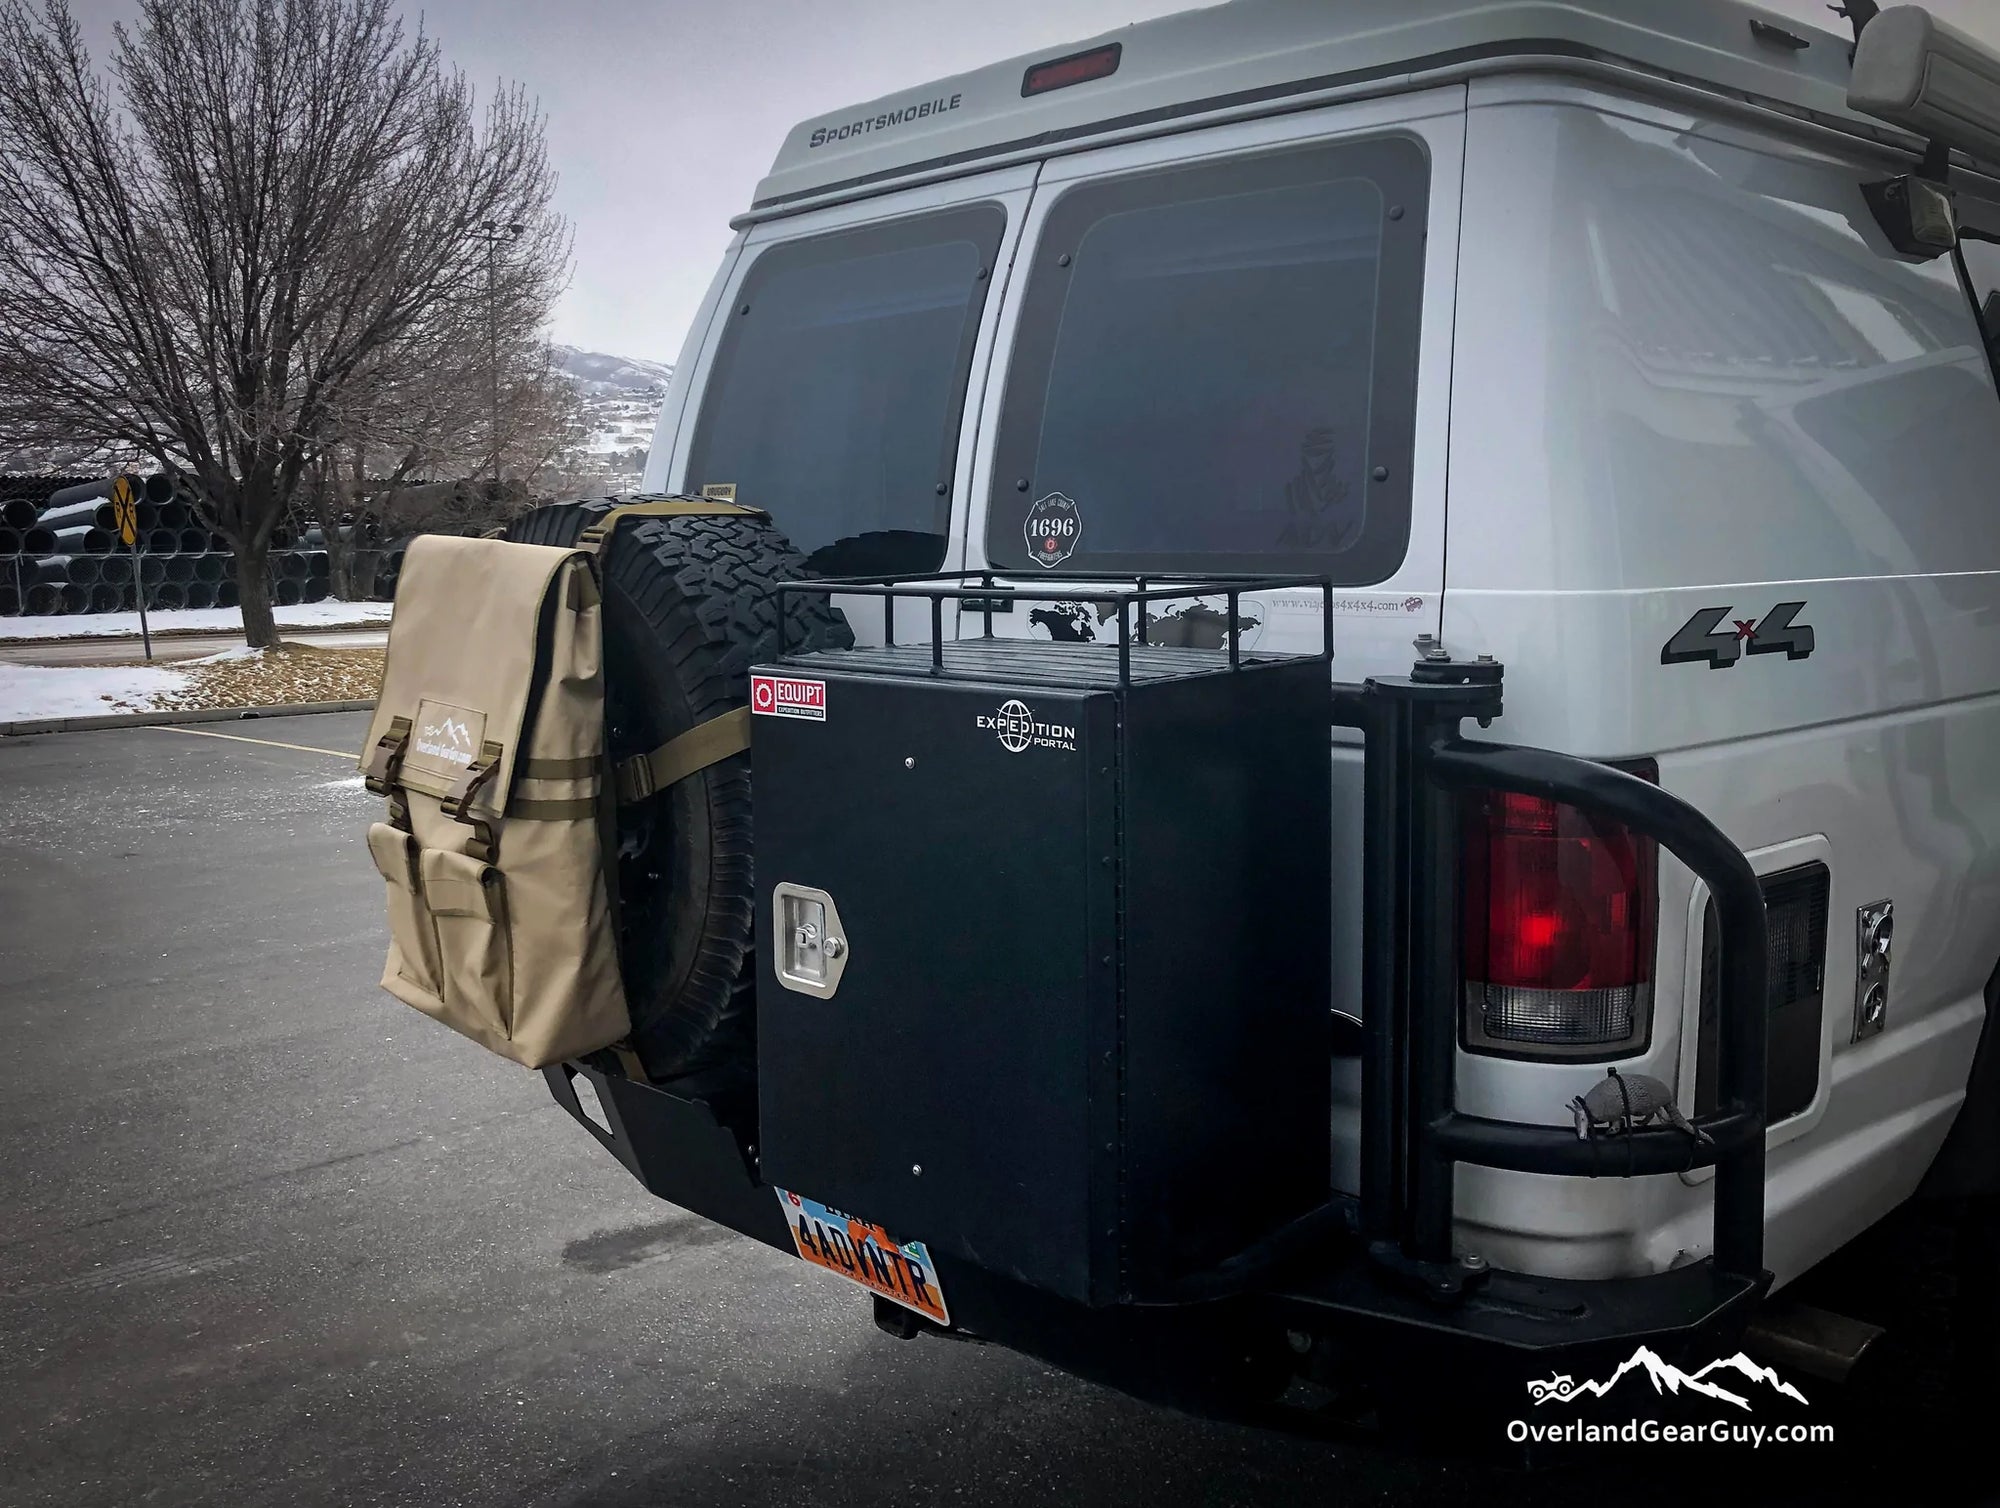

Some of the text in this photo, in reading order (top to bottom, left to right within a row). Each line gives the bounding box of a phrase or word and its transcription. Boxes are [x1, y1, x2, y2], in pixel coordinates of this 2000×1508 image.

[809, 93, 962, 148] SPORTSMOBILE
[1030, 517, 1074, 537] 1696
[777, 683, 822, 704] EQUIPT
[976, 715, 1075, 739] EXPEDITION
[1034, 737, 1077, 751] PORTAL
[799, 1213, 935, 1308] 4ADVNTR
